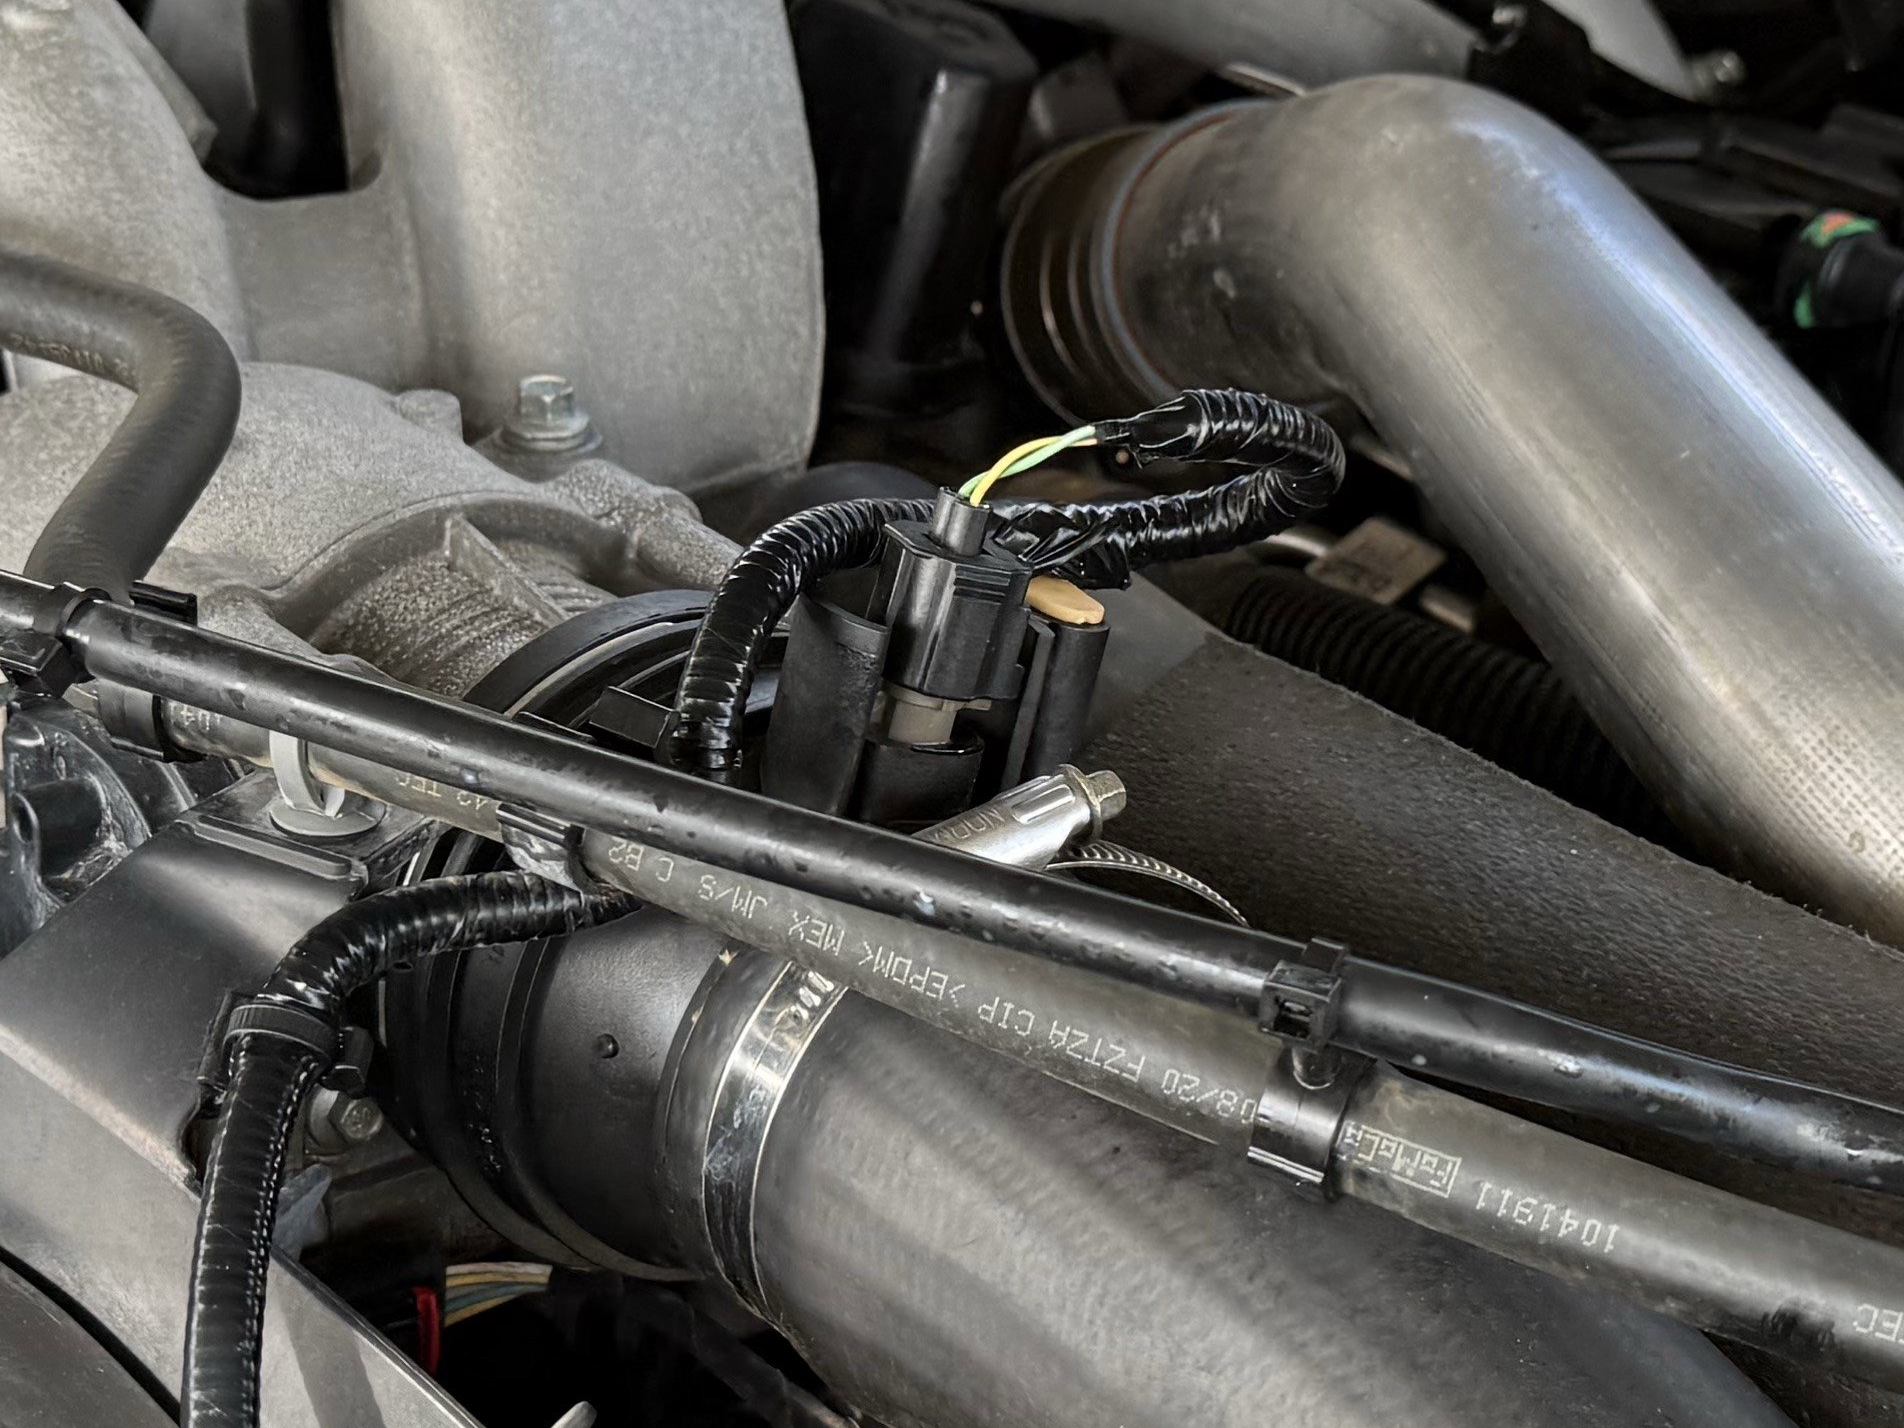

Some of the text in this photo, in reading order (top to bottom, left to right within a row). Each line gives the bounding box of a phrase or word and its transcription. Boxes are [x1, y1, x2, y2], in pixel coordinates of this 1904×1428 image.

[608, 839, 646, 872] B2
[654, 857, 676, 883] C
[697, 875, 769, 920] JM/S
[788, 912, 846, 957] MEX
[858, 941, 966, 1009] >EPDM<
[978, 997, 1035, 1038] CIP
[1048, 1019, 1146, 1084] FZTZA
[1161, 1068, 1256, 1125] 08/20
[1475, 1181, 1620, 1254] 1041911
